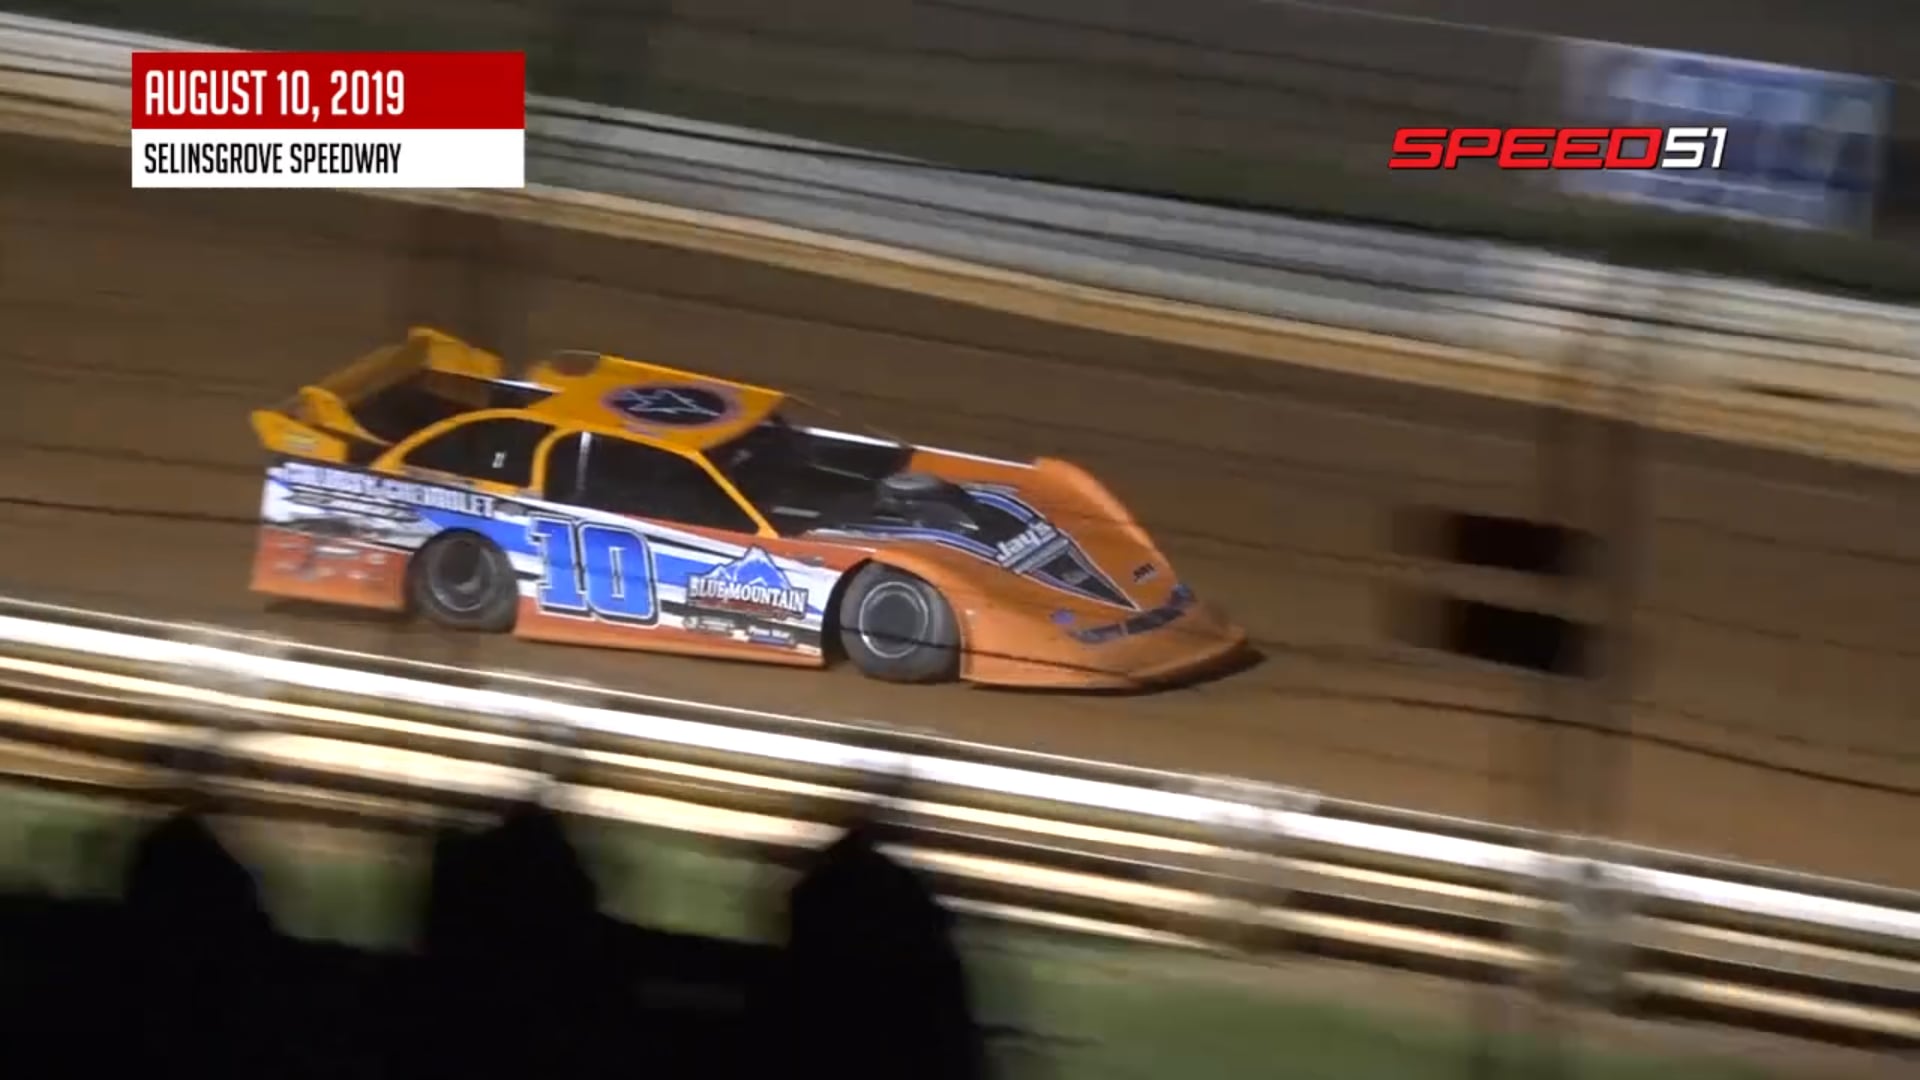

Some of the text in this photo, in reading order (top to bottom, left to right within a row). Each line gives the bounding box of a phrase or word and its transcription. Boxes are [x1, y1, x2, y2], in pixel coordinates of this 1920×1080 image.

[527, 513, 660, 627] 10
[688, 574, 727, 600] BLUE
[728, 582, 807, 614] MOUNTAIN
